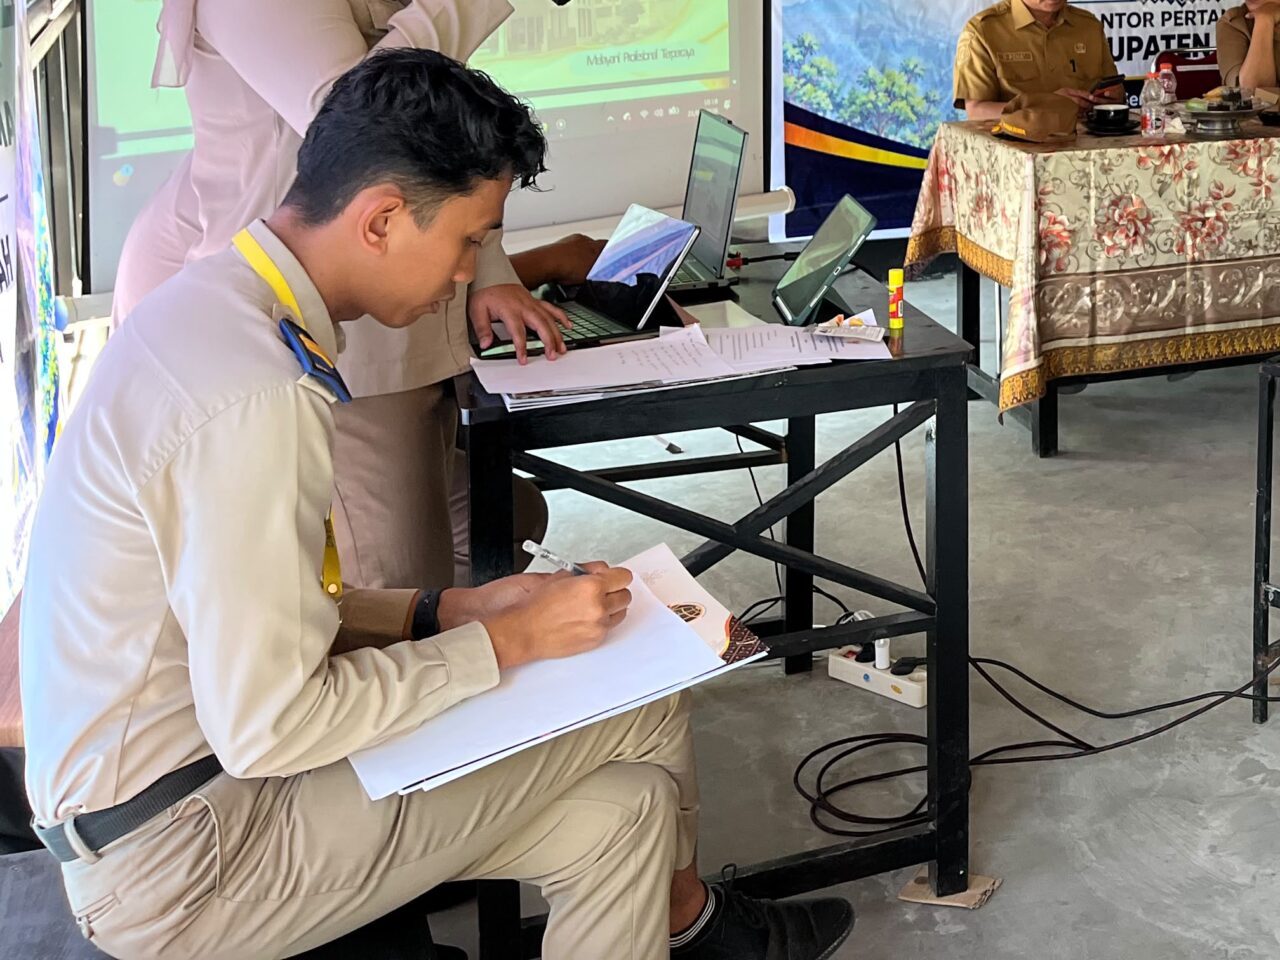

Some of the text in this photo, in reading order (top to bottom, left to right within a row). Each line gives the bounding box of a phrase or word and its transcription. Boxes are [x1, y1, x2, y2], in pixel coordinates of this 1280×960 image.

[1101, 9, 1225, 29] NTOR PERTA
[1107, 33, 1210, 62] UPATEN
